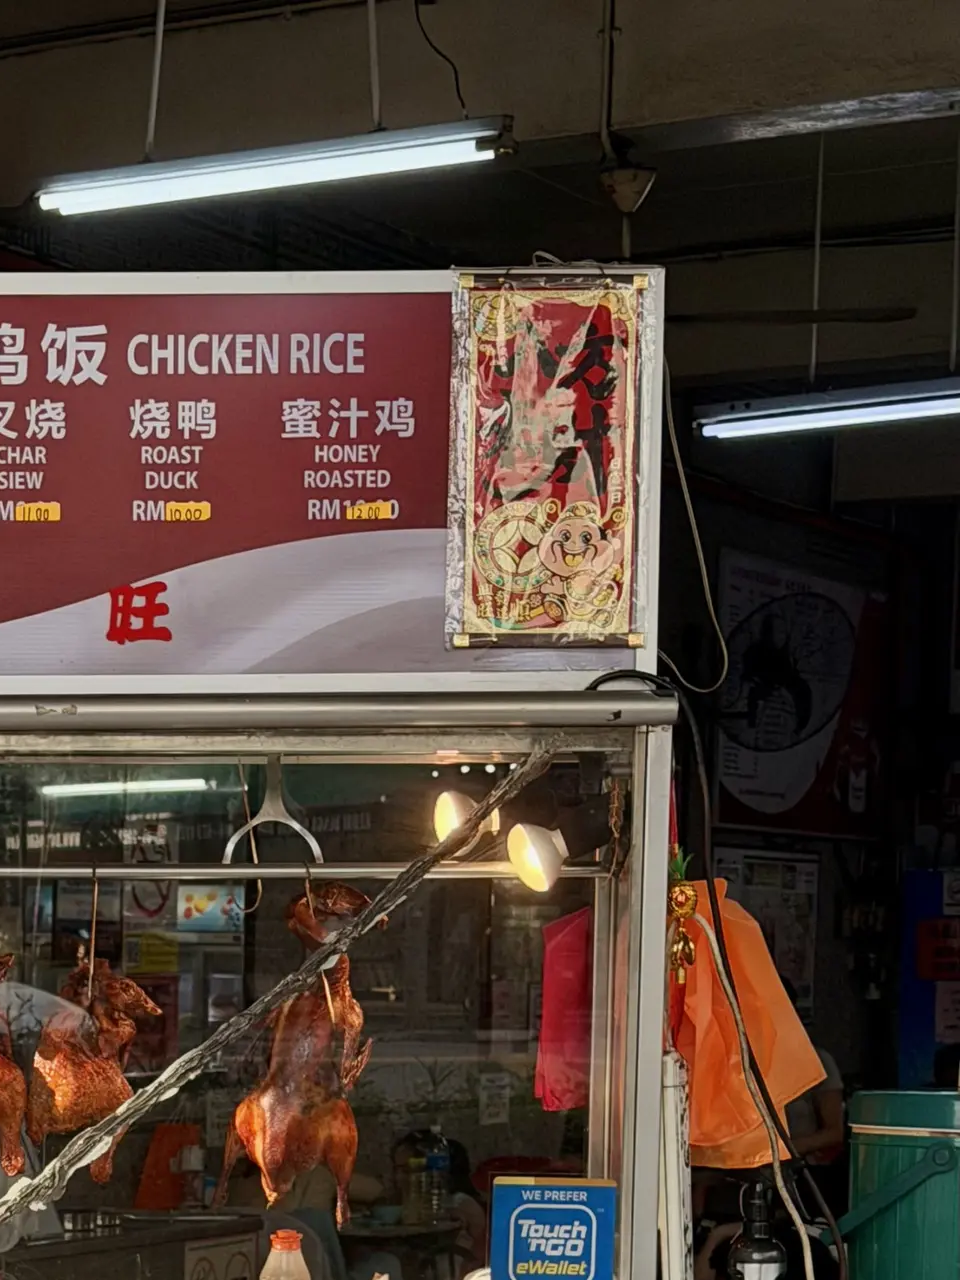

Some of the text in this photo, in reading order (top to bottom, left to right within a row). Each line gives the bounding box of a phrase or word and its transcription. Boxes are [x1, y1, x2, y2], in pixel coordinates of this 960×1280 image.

[127, 332, 366, 375] CHICKEN RICE
[129, 398, 217, 440] 烧鸭
[281, 397, 416, 439] 蜜汁鸡
[141, 445, 203, 465] ROAST
[314, 444, 381, 463] HONEY
[145, 471, 198, 490] DUCK
[304, 469, 391, 489] ROASTED
[106, 581, 172, 644] 旺
[521, 1190, 588, 1202] WE PREFER
[518, 1219, 587, 1239] Touch
[516, 1260, 588, 1275] eWallet
